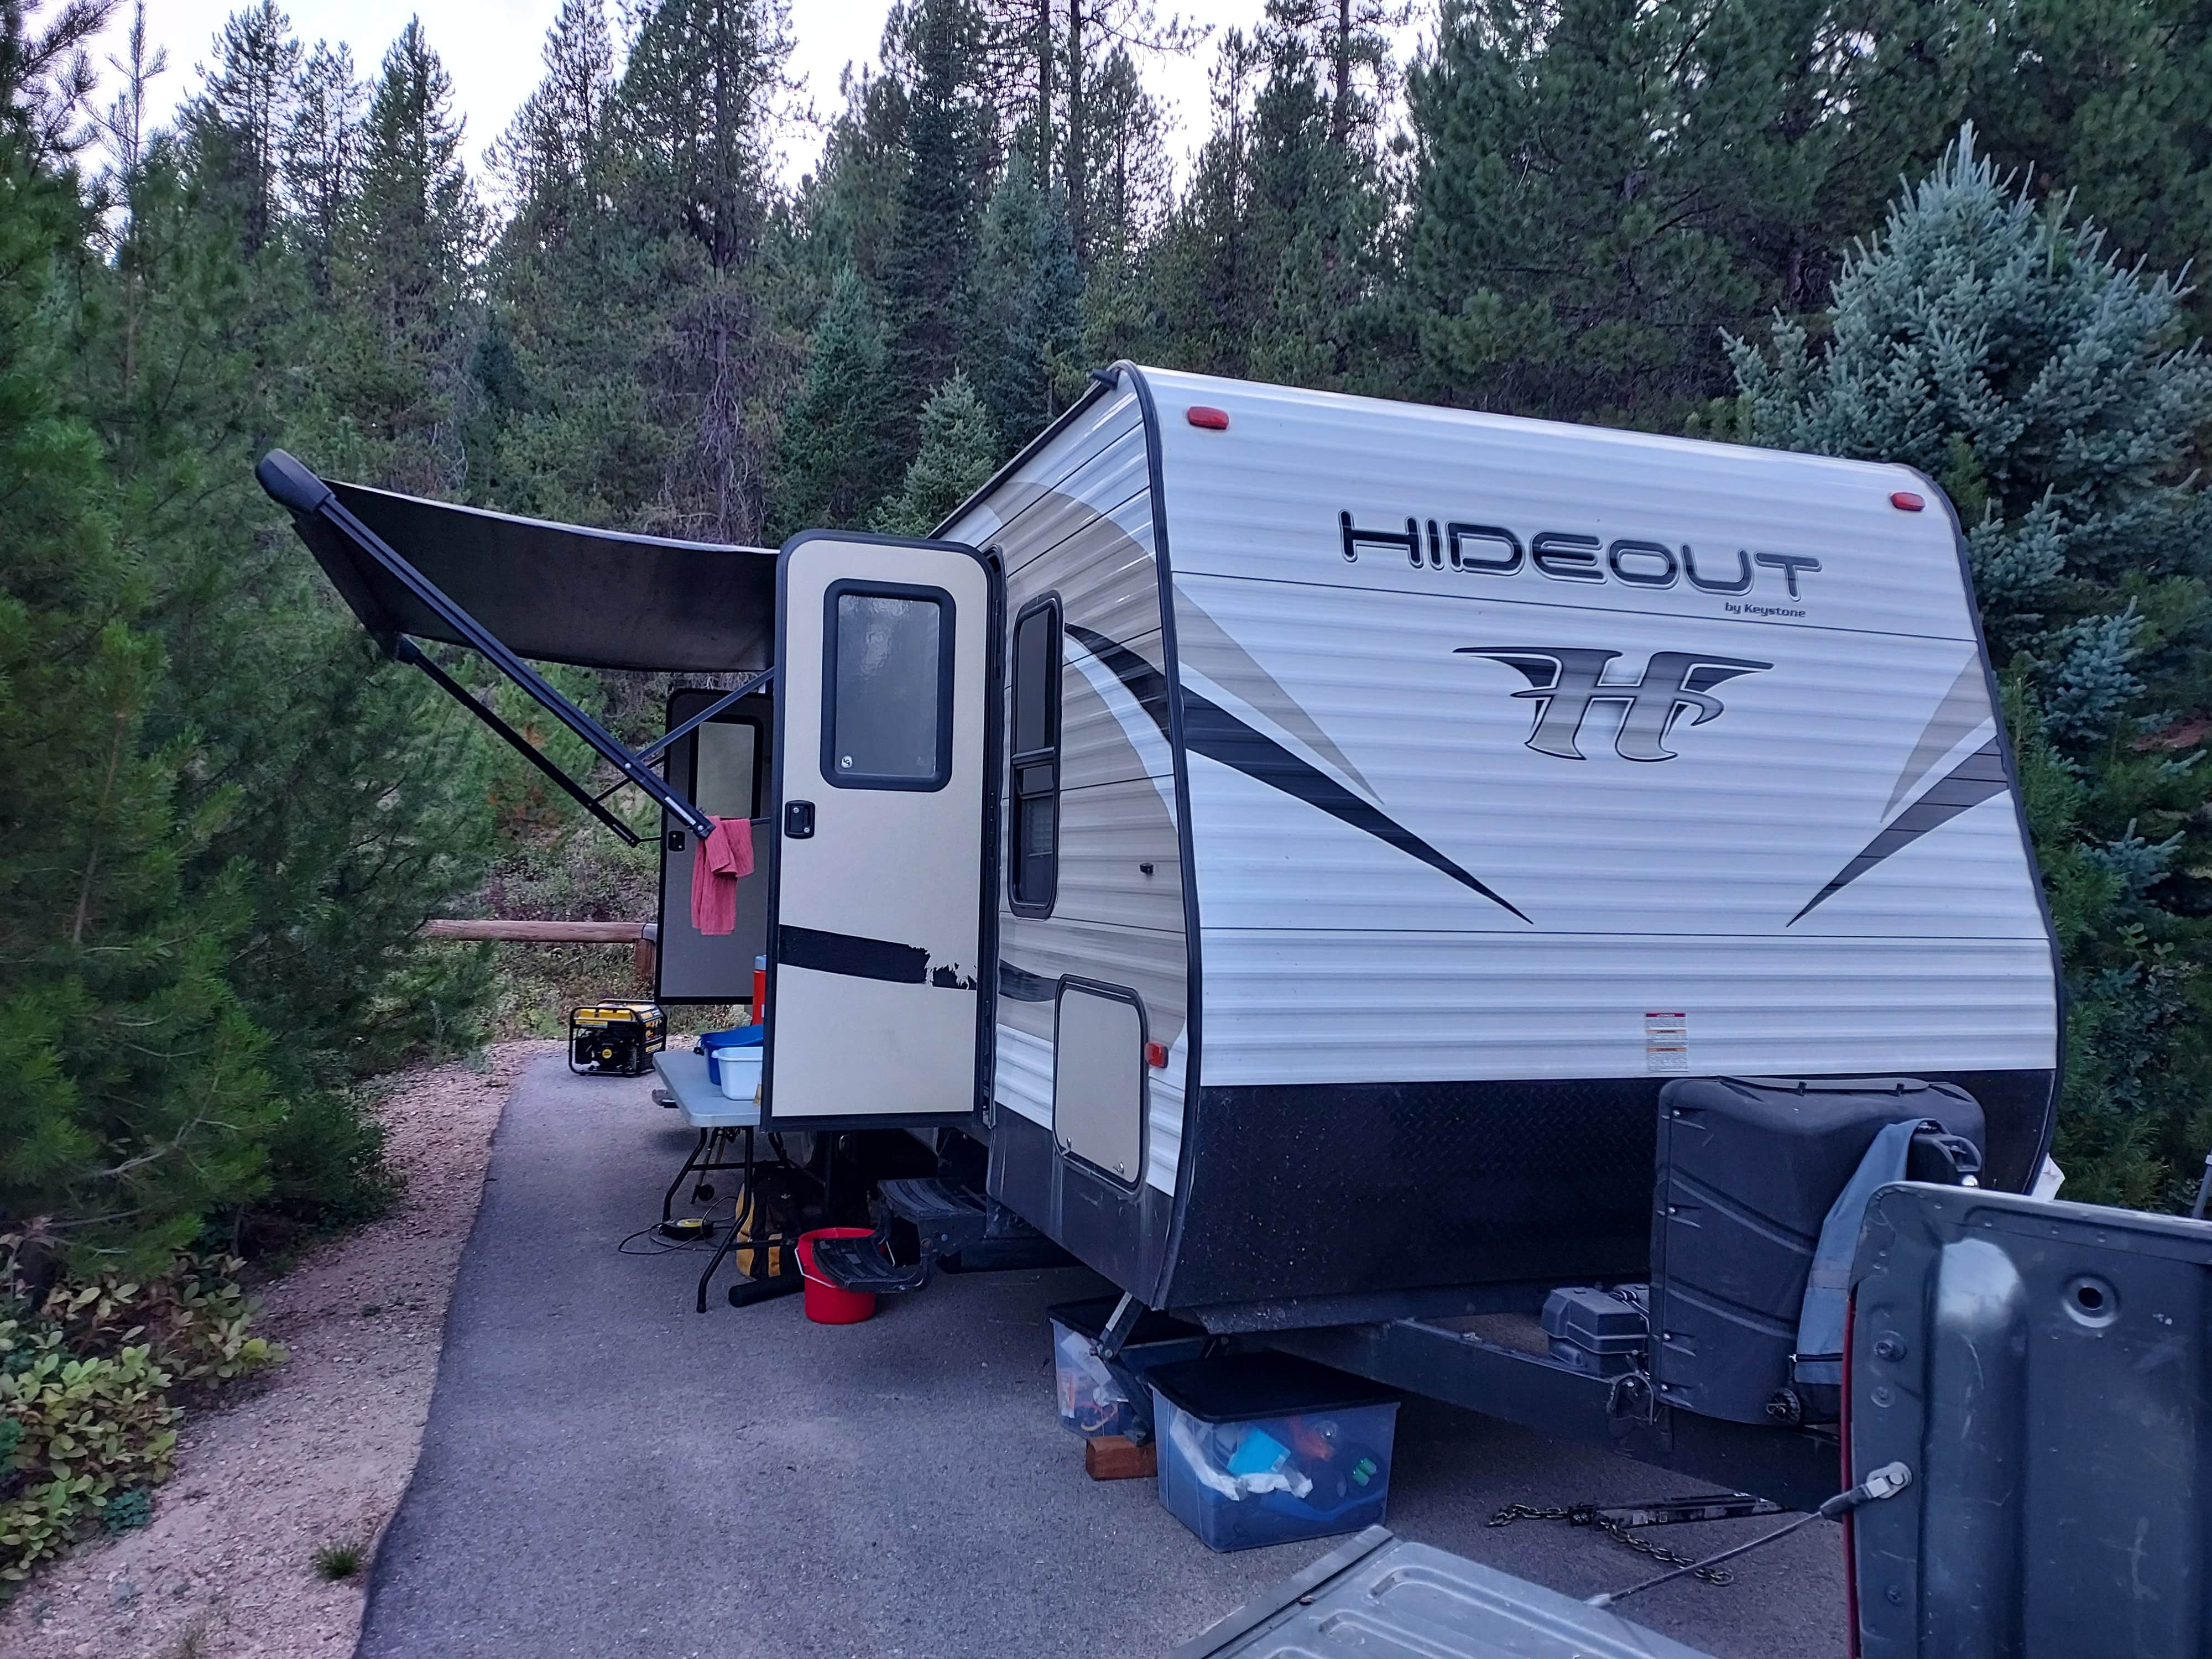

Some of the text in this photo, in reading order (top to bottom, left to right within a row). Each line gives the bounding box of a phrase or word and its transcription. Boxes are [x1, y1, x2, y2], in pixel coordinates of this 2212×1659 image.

[1338, 509, 1823, 601] HIDEOUT
[1725, 602, 1806, 618] by Keystone
